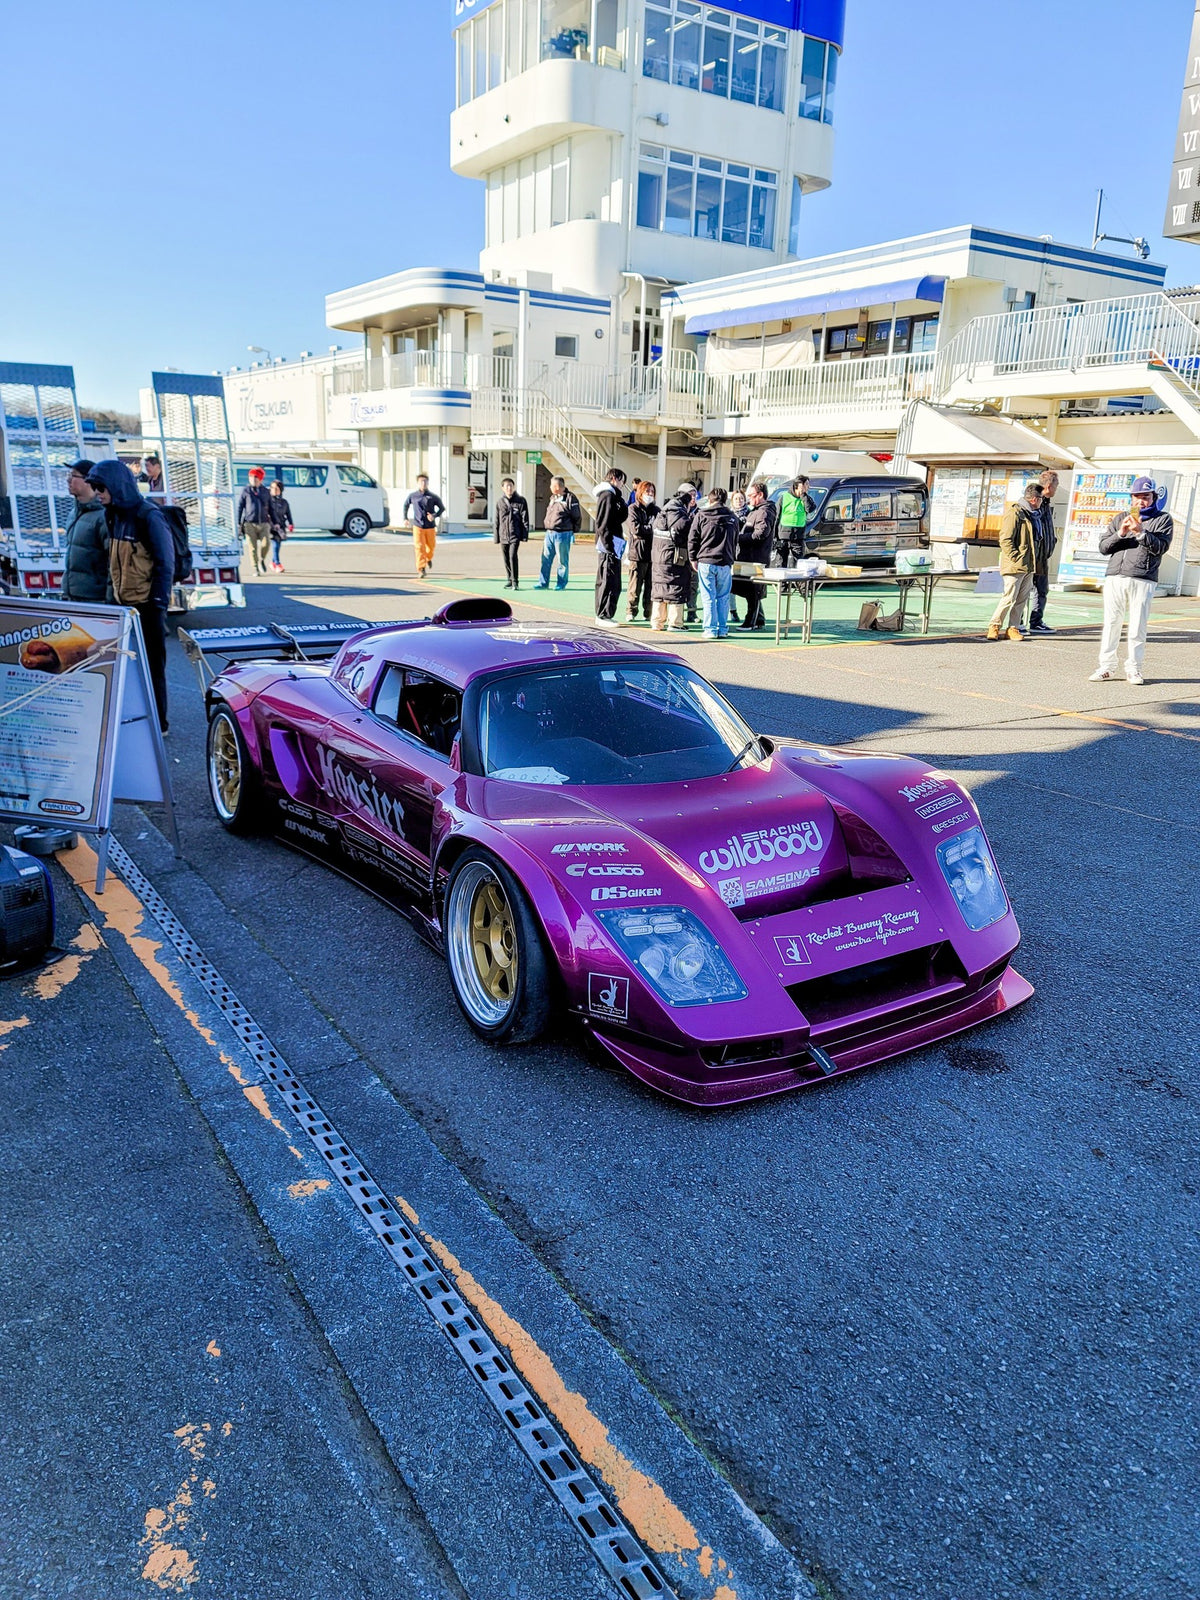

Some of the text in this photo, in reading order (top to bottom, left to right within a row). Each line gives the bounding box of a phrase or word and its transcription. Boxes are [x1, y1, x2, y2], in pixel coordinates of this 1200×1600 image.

[254, 400, 294, 418] TSUKUBA
[41, 617, 72, 638] DOG
[315, 742, 406, 839] Hoosier
[759, 822, 812, 839] RACING
[699, 821, 823, 874] wilwood
[745, 867, 820, 891] SAMSONAS
[628, 888, 662, 898] GIKEN
[806, 909, 920, 945] Rocket Bunny Racing
